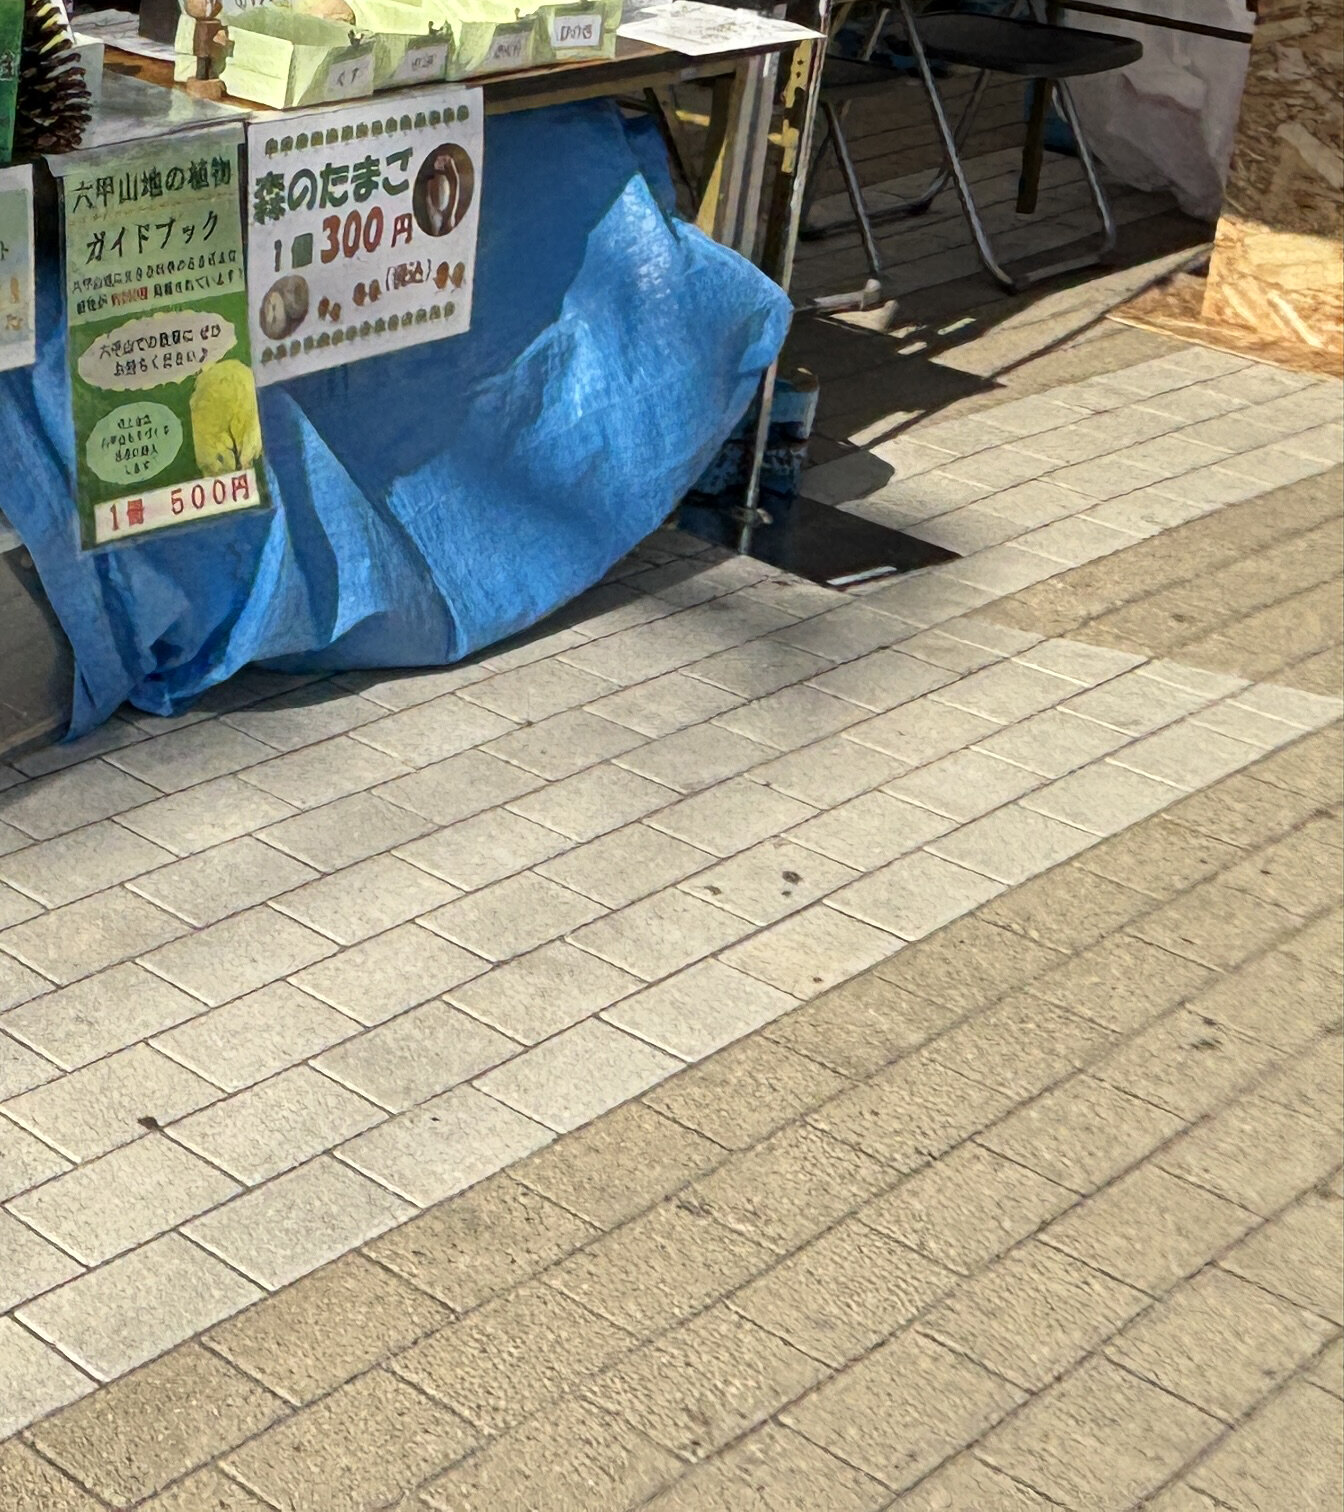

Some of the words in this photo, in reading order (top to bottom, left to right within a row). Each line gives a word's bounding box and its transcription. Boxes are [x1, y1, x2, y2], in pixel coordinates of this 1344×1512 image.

[253, 147, 414, 225] 森のたまご
[86, 210, 220, 266] ガイドブック
[169, 472, 251, 516] 500円
